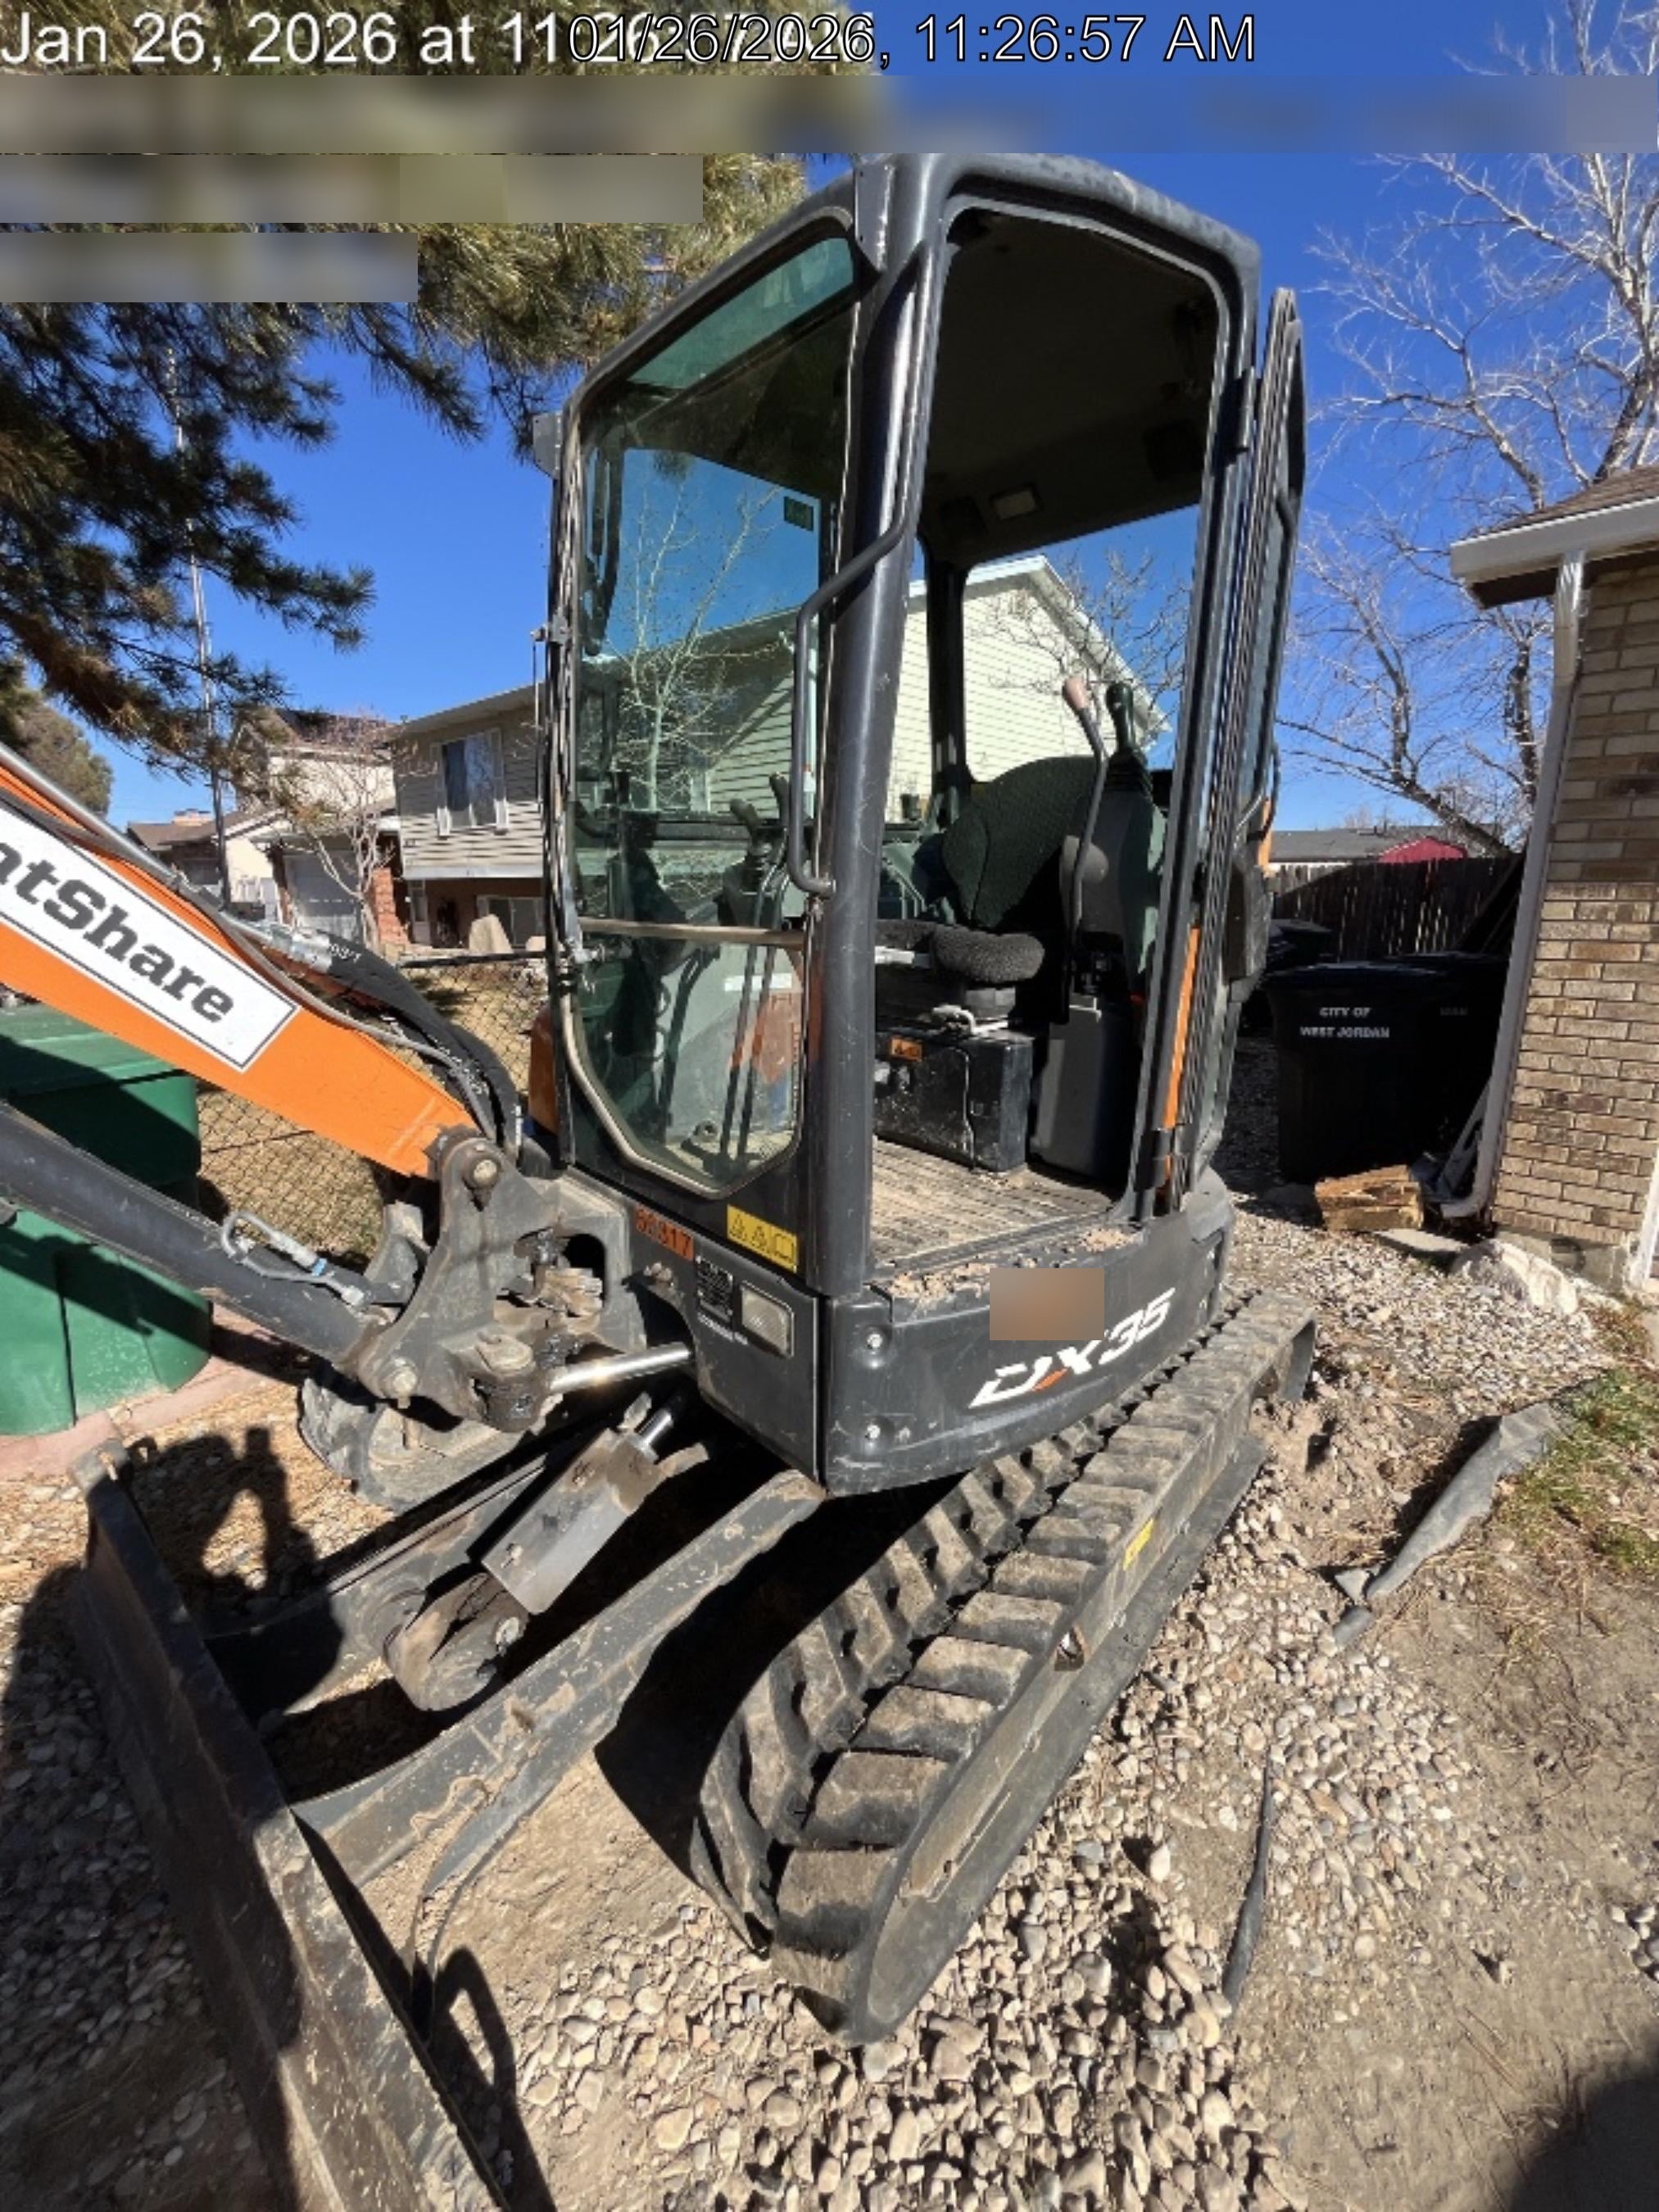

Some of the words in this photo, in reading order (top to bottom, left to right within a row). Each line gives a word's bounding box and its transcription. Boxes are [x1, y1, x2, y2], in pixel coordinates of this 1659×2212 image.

[1319, 1007, 1350, 1017] CITY
[1353, 1007, 1371, 1017] OF
[1299, 1027, 1335, 1036] WEST
[1337, 1027, 1389, 1038] JORDAN
